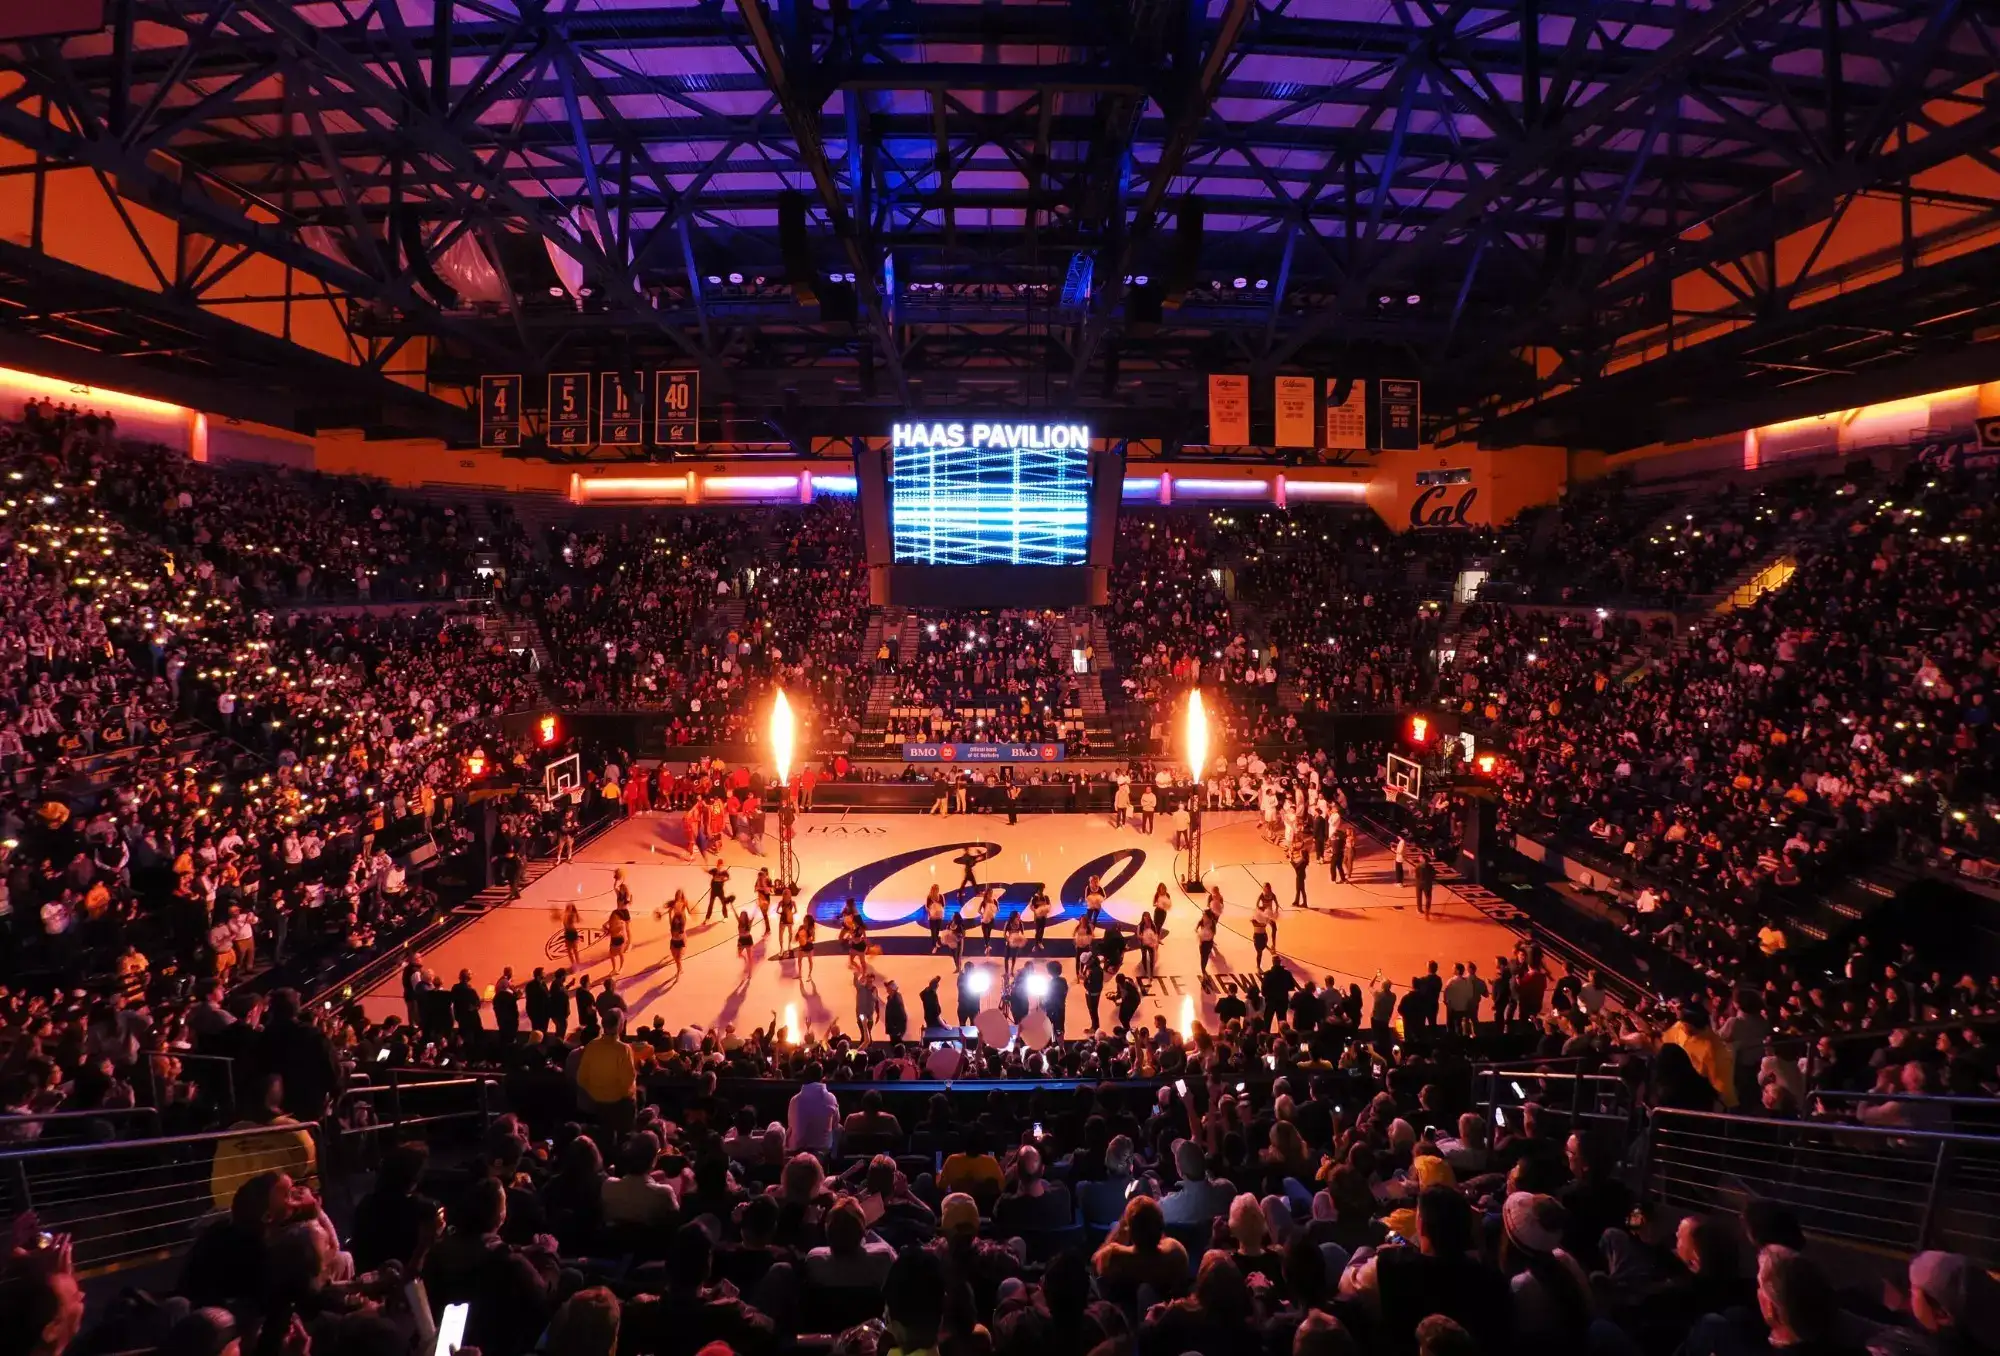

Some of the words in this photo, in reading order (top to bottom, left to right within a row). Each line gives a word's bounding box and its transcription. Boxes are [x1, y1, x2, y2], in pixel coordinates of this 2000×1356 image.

[494, 387, 506, 414] 4
[563, 385, 574, 412] 5
[664, 383, 688, 410] 40
[893, 424, 965, 447] HAAS
[972, 424, 1089, 448] PAVILION
[1409, 485, 1478, 528] Cal
[910, 748, 937, 757] BMO
[1011, 748, 1038, 757] BMO
[807, 826, 888, 834] HAAS
[768, 841, 1169, 961] Cal
